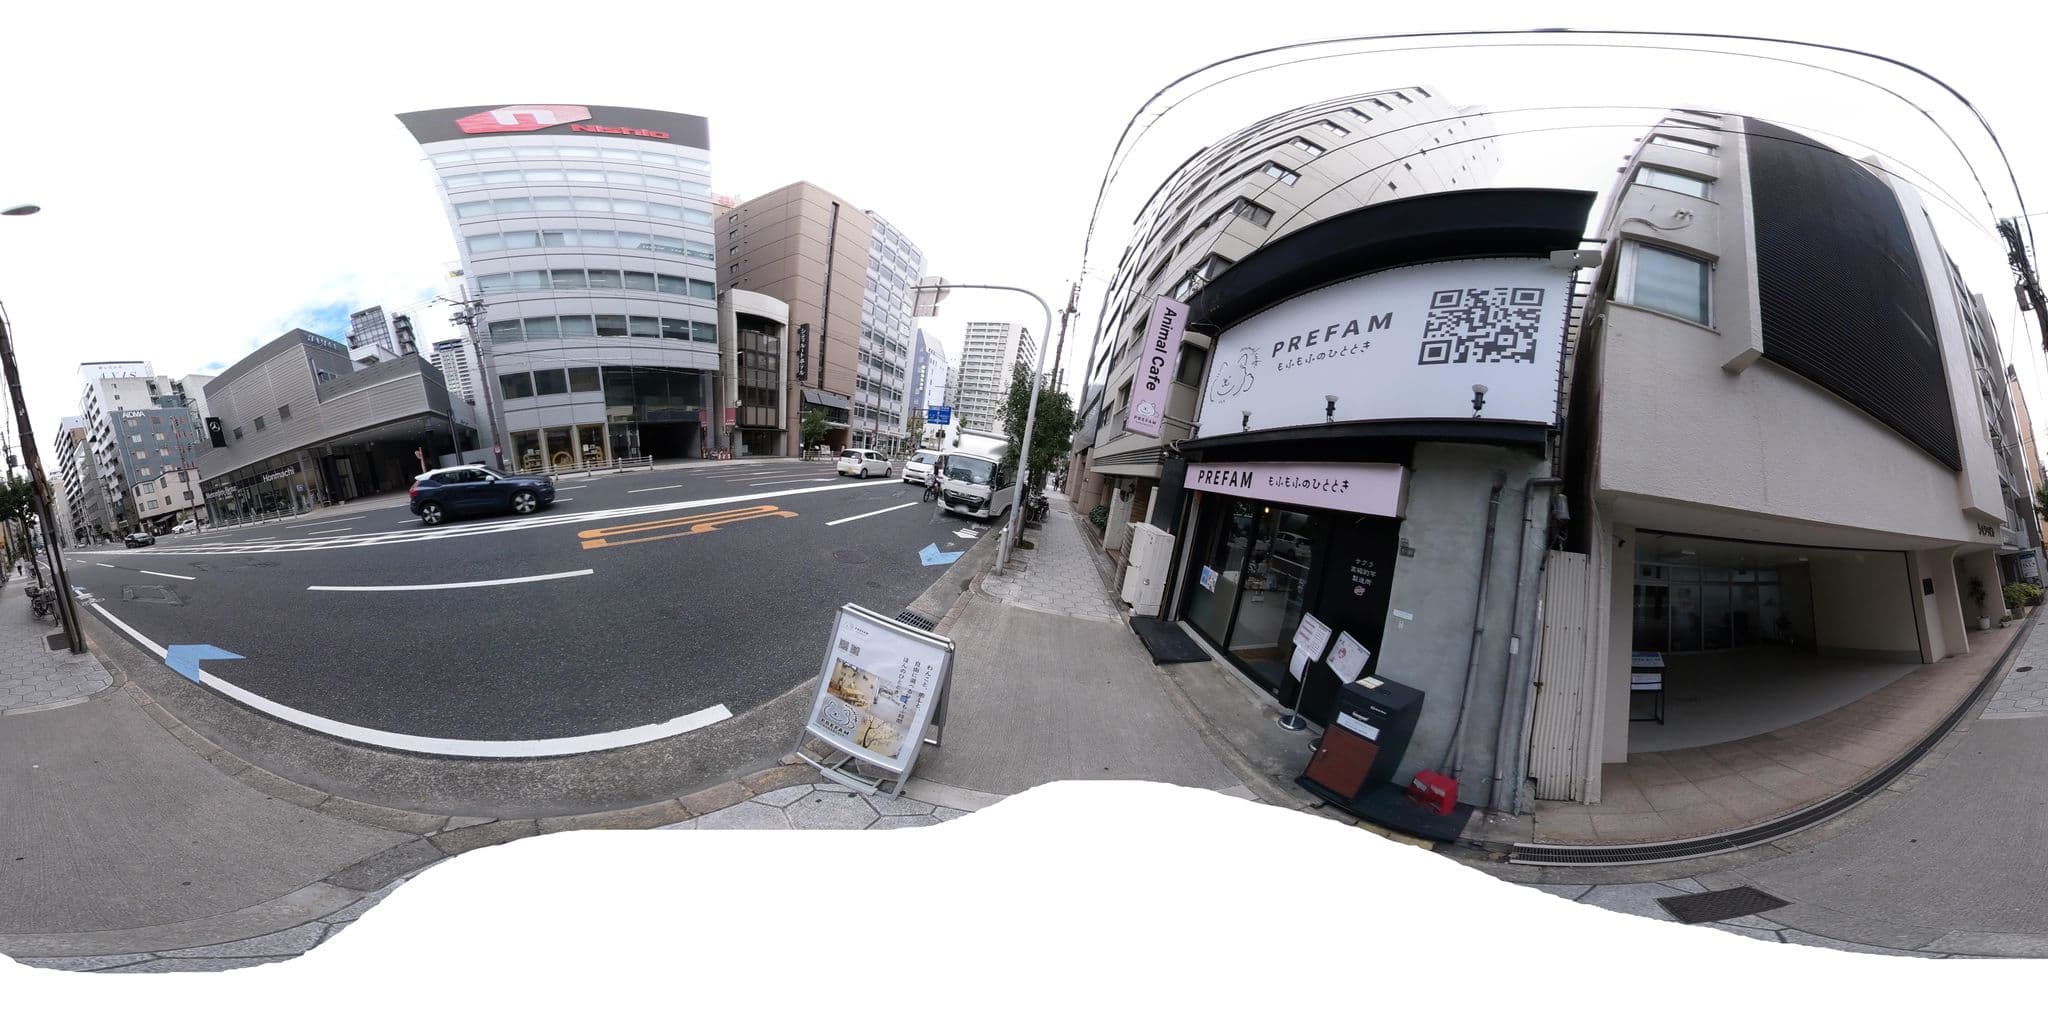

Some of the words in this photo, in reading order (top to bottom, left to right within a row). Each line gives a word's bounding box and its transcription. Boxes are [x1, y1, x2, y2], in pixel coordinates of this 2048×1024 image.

[570, 123, 671, 140] Nishio
[1155, 306, 1178, 354] Animal
[1271, 311, 1394, 358] PREFAM
[1277, 340, 1371, 371] もふもふのひととき
[1146, 356, 1166, 391] Cafe
[1133, 415, 1157, 425] PREFAM
[262, 465, 295, 482] Honmachi
[1198, 469, 1253, 489] PREFAM
[1268, 475, 1350, 493] もふもふのひととき
[820, 718, 850, 736] PREFAM
